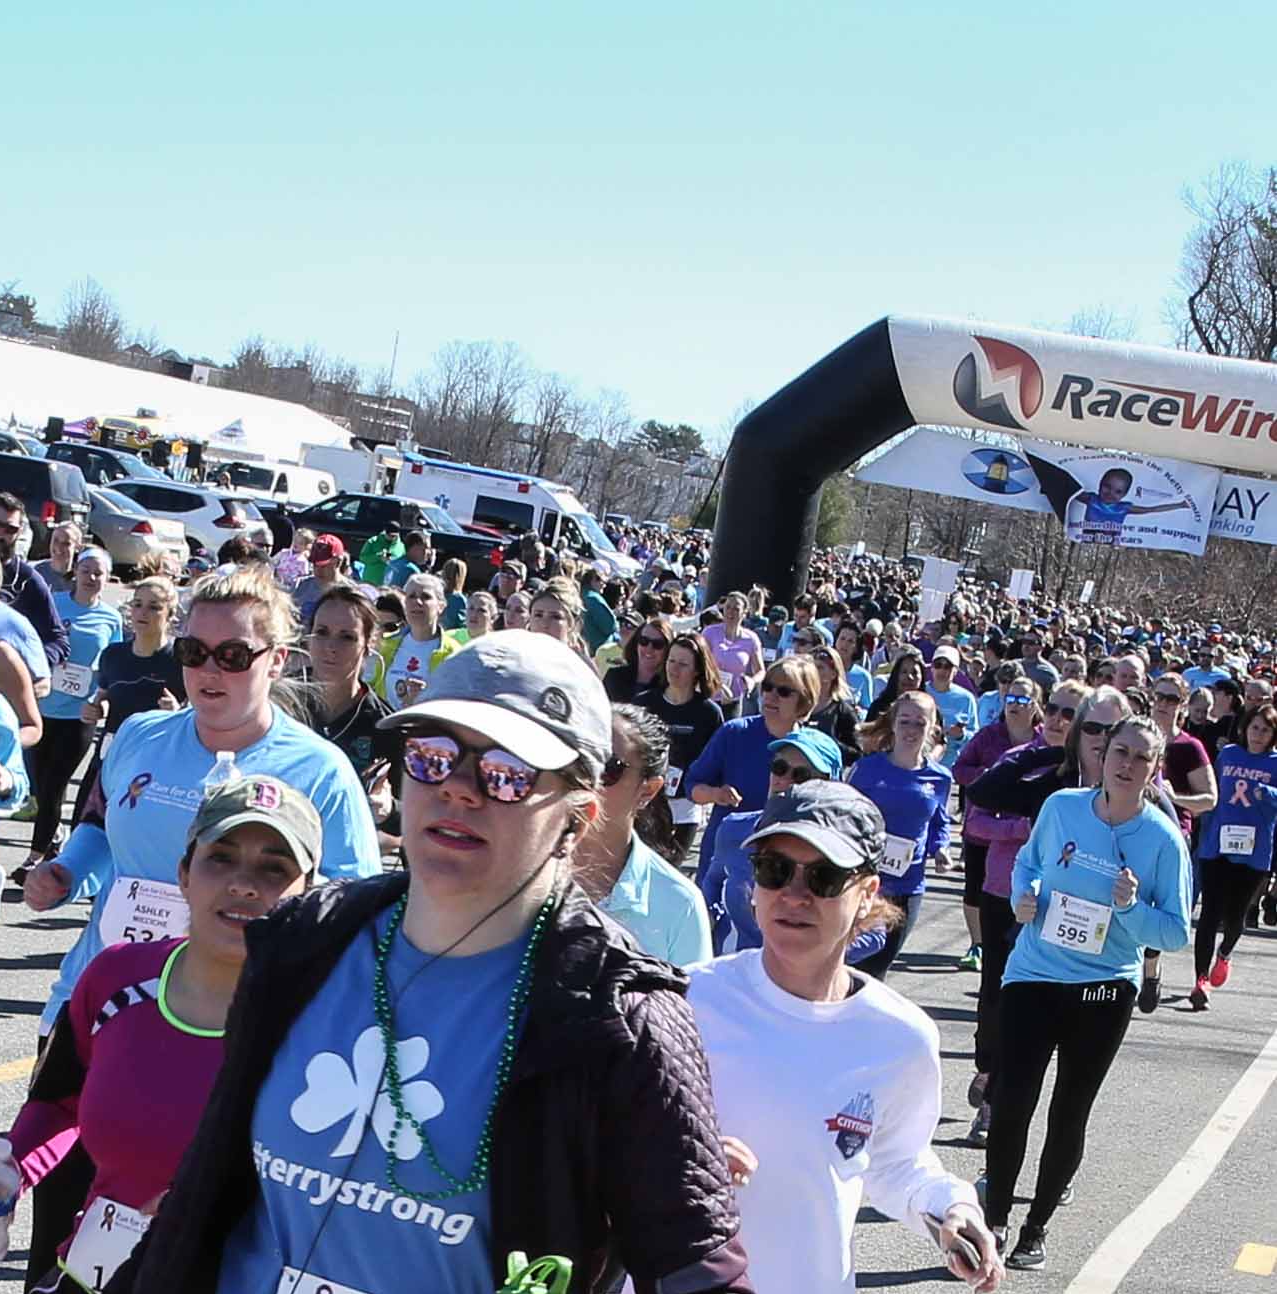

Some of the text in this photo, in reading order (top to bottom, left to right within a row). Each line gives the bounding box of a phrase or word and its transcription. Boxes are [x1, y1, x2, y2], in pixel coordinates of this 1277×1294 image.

[1213, 486, 1271, 521] AY
[1138, 526, 1158, 534] and
[1161, 528, 1202, 544] support
[1223, 766, 1271, 783] WAMPS
[245, 782, 283, 811] B
[135, 904, 171, 918] ASHLEY
[123, 926, 171, 943] 53
[1057, 924, 1088, 944] 595
